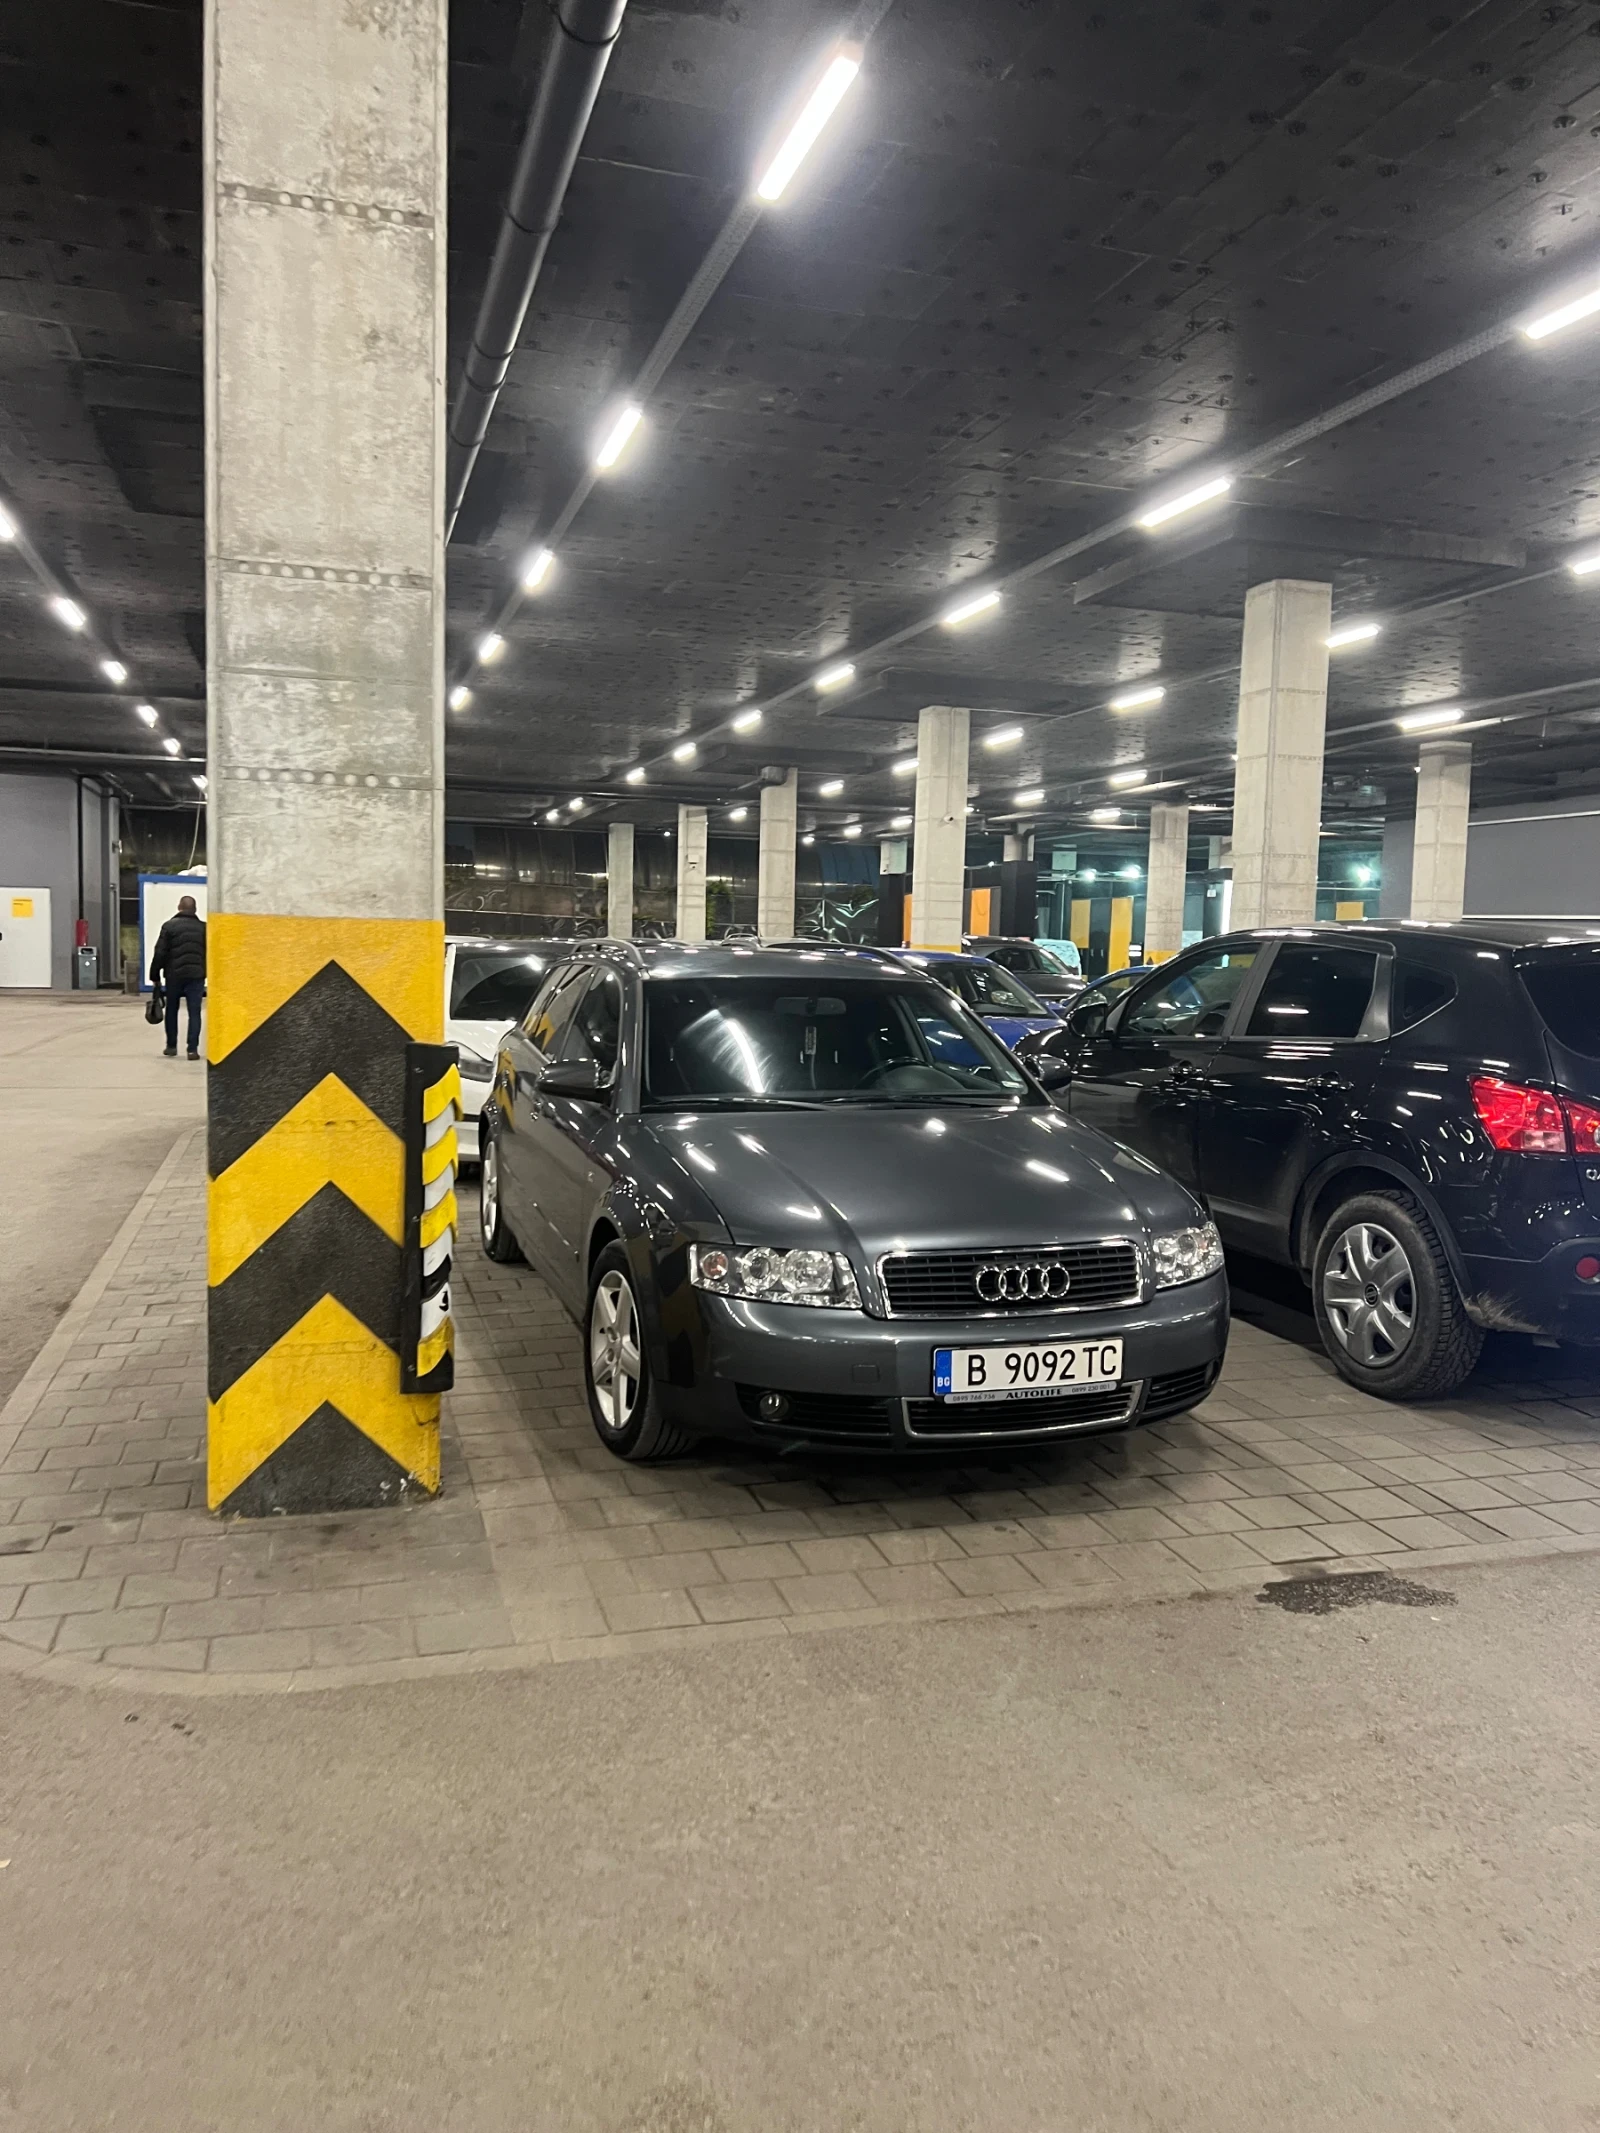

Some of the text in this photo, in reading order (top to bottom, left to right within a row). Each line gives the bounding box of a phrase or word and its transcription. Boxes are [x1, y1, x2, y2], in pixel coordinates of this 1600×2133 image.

[1586, 1169, 1600, 1182] Q
[967, 1345, 1117, 1386] B 9092 TC
[937, 1376, 950, 1388] BG
[1005, 1388, 1062, 1399] AUTOLIFE
